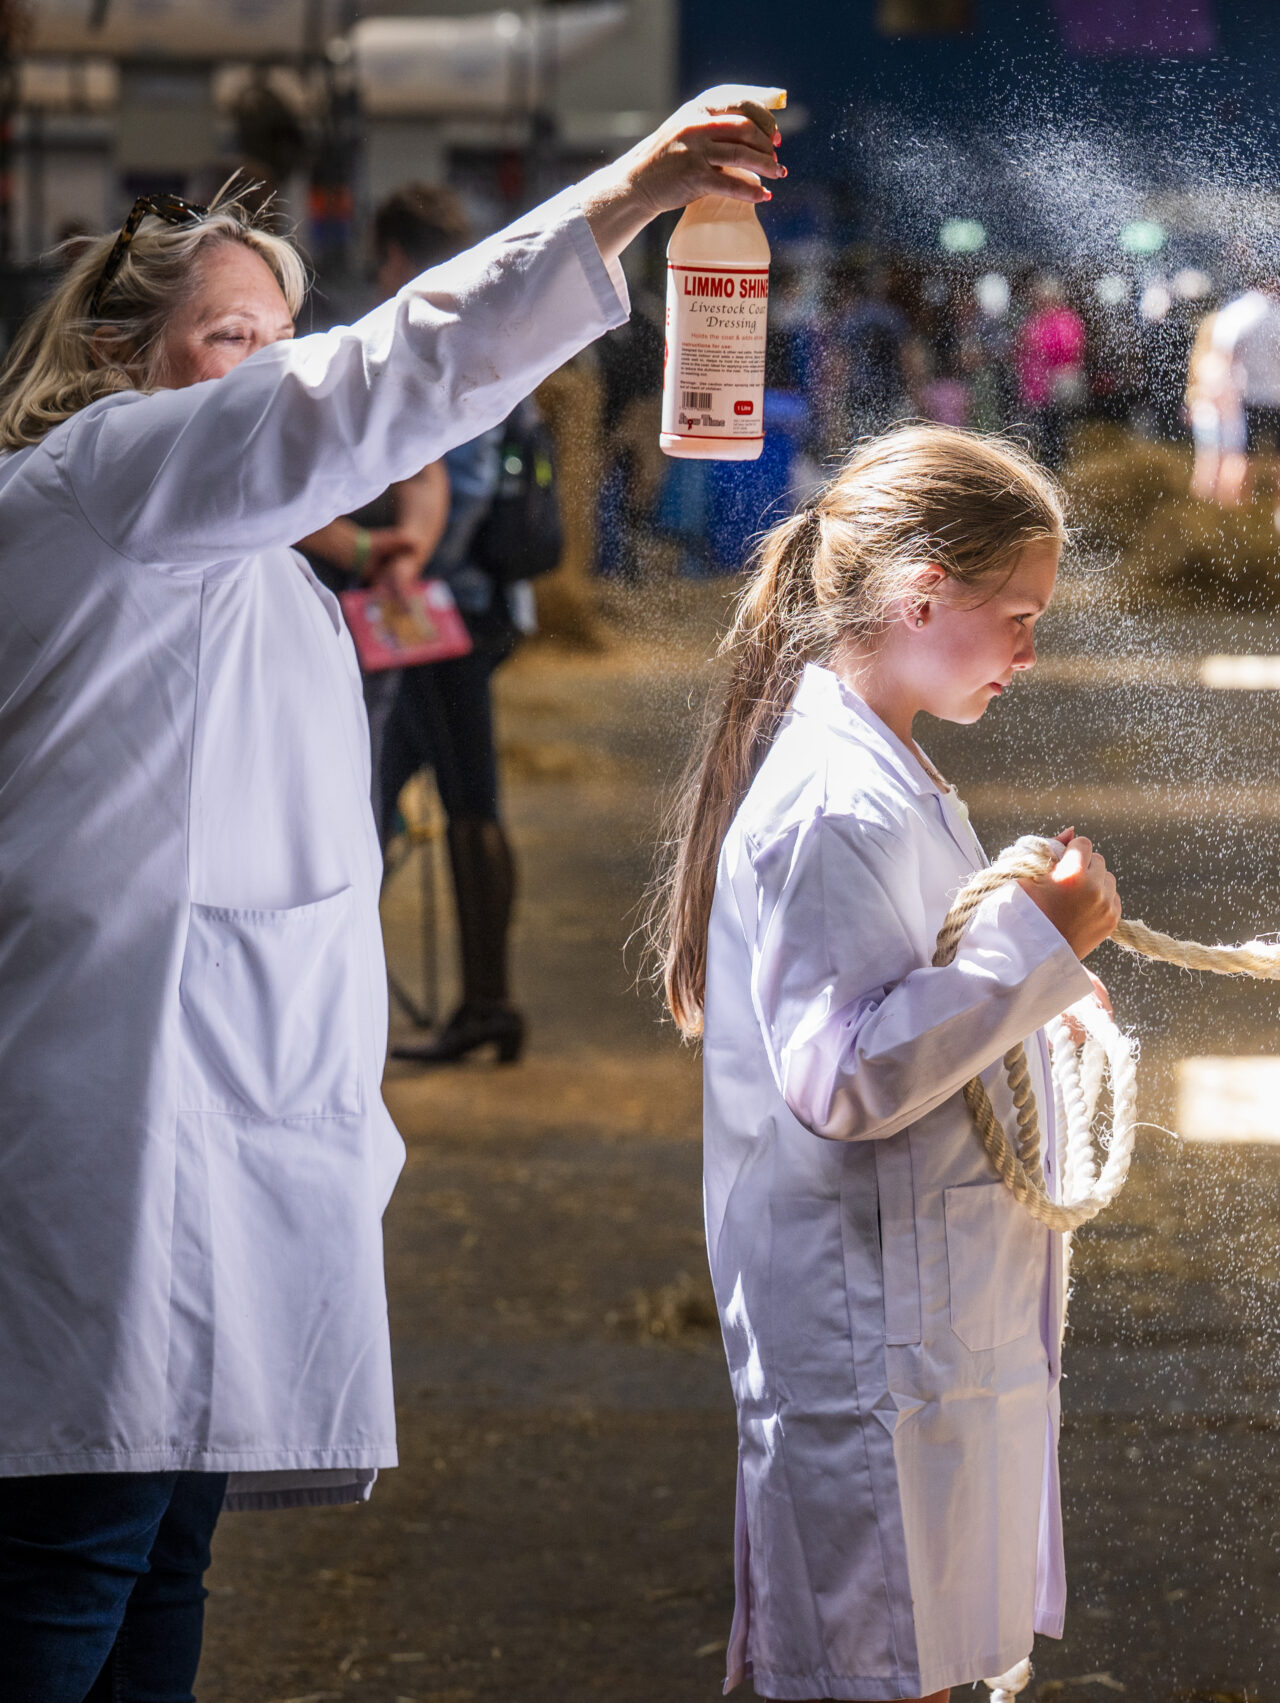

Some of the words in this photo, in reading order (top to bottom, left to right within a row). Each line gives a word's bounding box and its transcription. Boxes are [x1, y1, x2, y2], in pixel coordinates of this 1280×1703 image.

[684, 275, 735, 298] LIMMO
[689, 300, 745, 314] Livestock
[706, 316, 757, 334] Dressing
